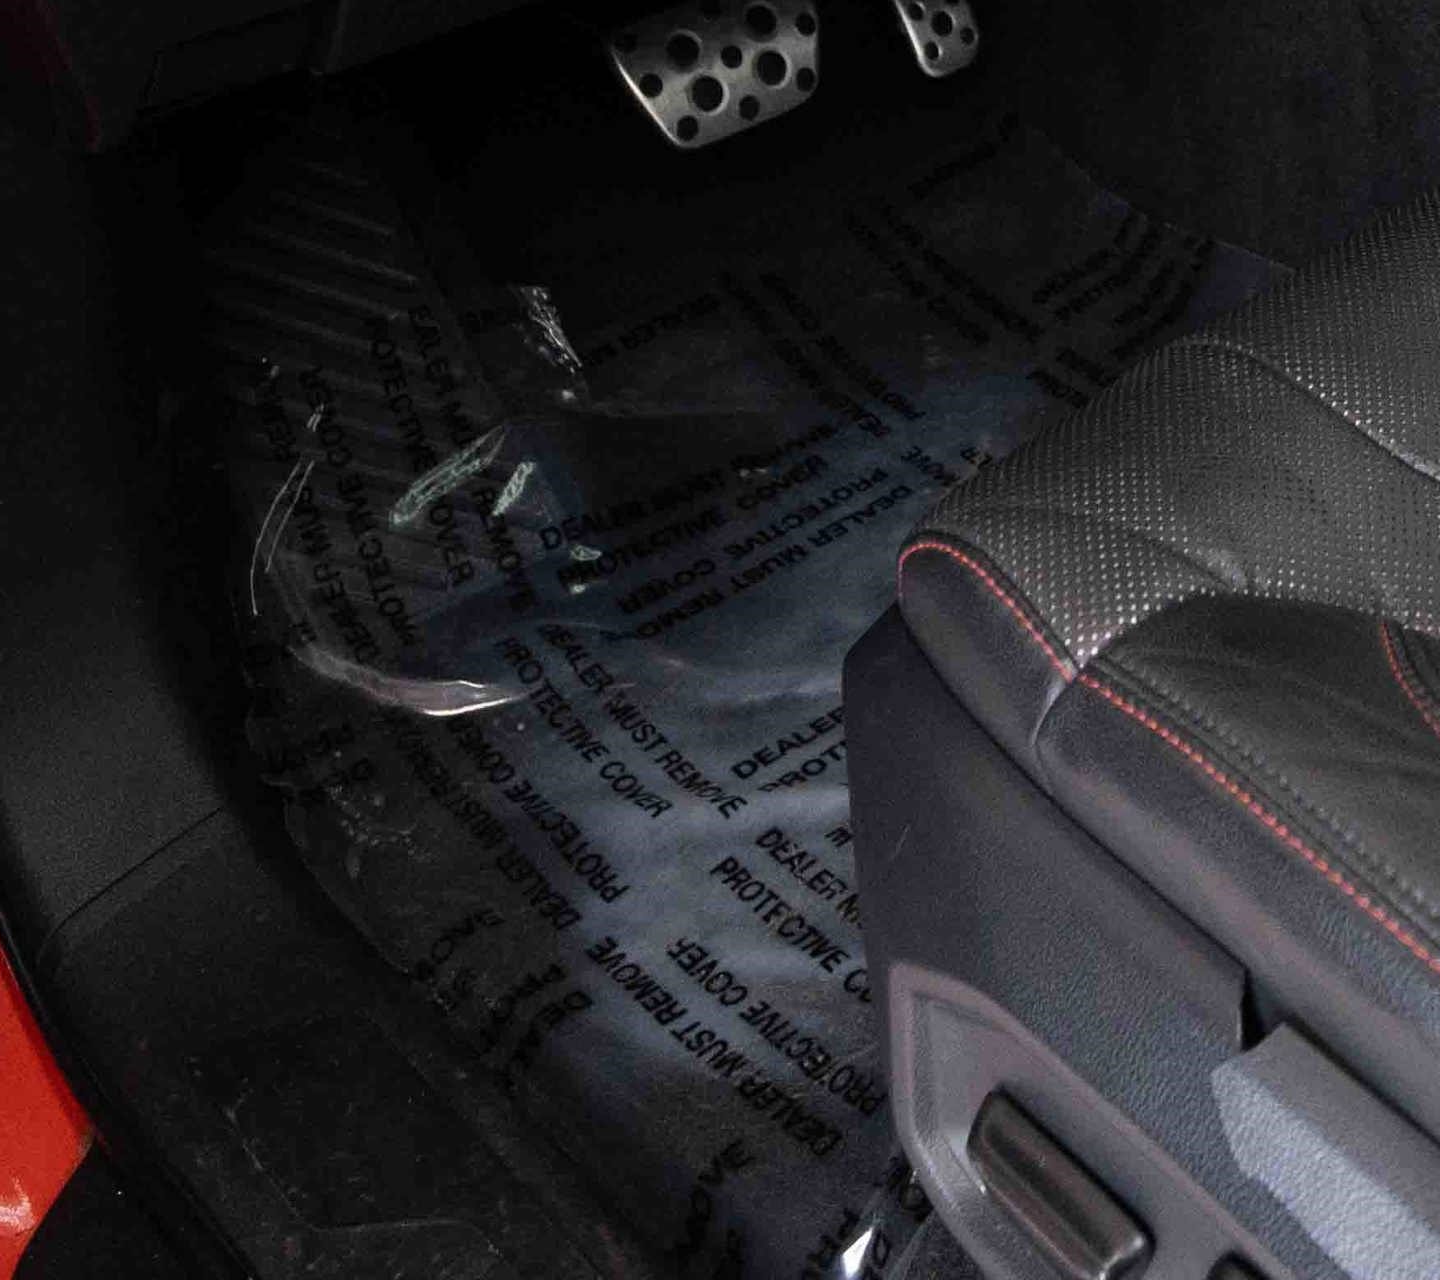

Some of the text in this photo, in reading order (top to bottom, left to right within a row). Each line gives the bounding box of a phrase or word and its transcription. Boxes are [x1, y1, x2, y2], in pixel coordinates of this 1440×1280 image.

[428, 496, 476, 585] OVER
[616, 466, 890, 617] PROTECTIVE COVER
[728, 542, 810, 594] MUST
[806, 483, 914, 549] DEALER
[494, 636, 675, 819] PROTECTIVE COVER
[603, 690, 669, 754] MUST
[653, 742, 749, 821] REMOVE
[503, 778, 631, 905] PROTECTIVE
[755, 826, 850, 902] DEALER
[709, 855, 852, 974] PROTECTIVE
[584, 936, 690, 1027] REMOVE
[665, 936, 888, 1117] PROTECTIVE COVER
[670, 1019, 747, 1080] MUST
